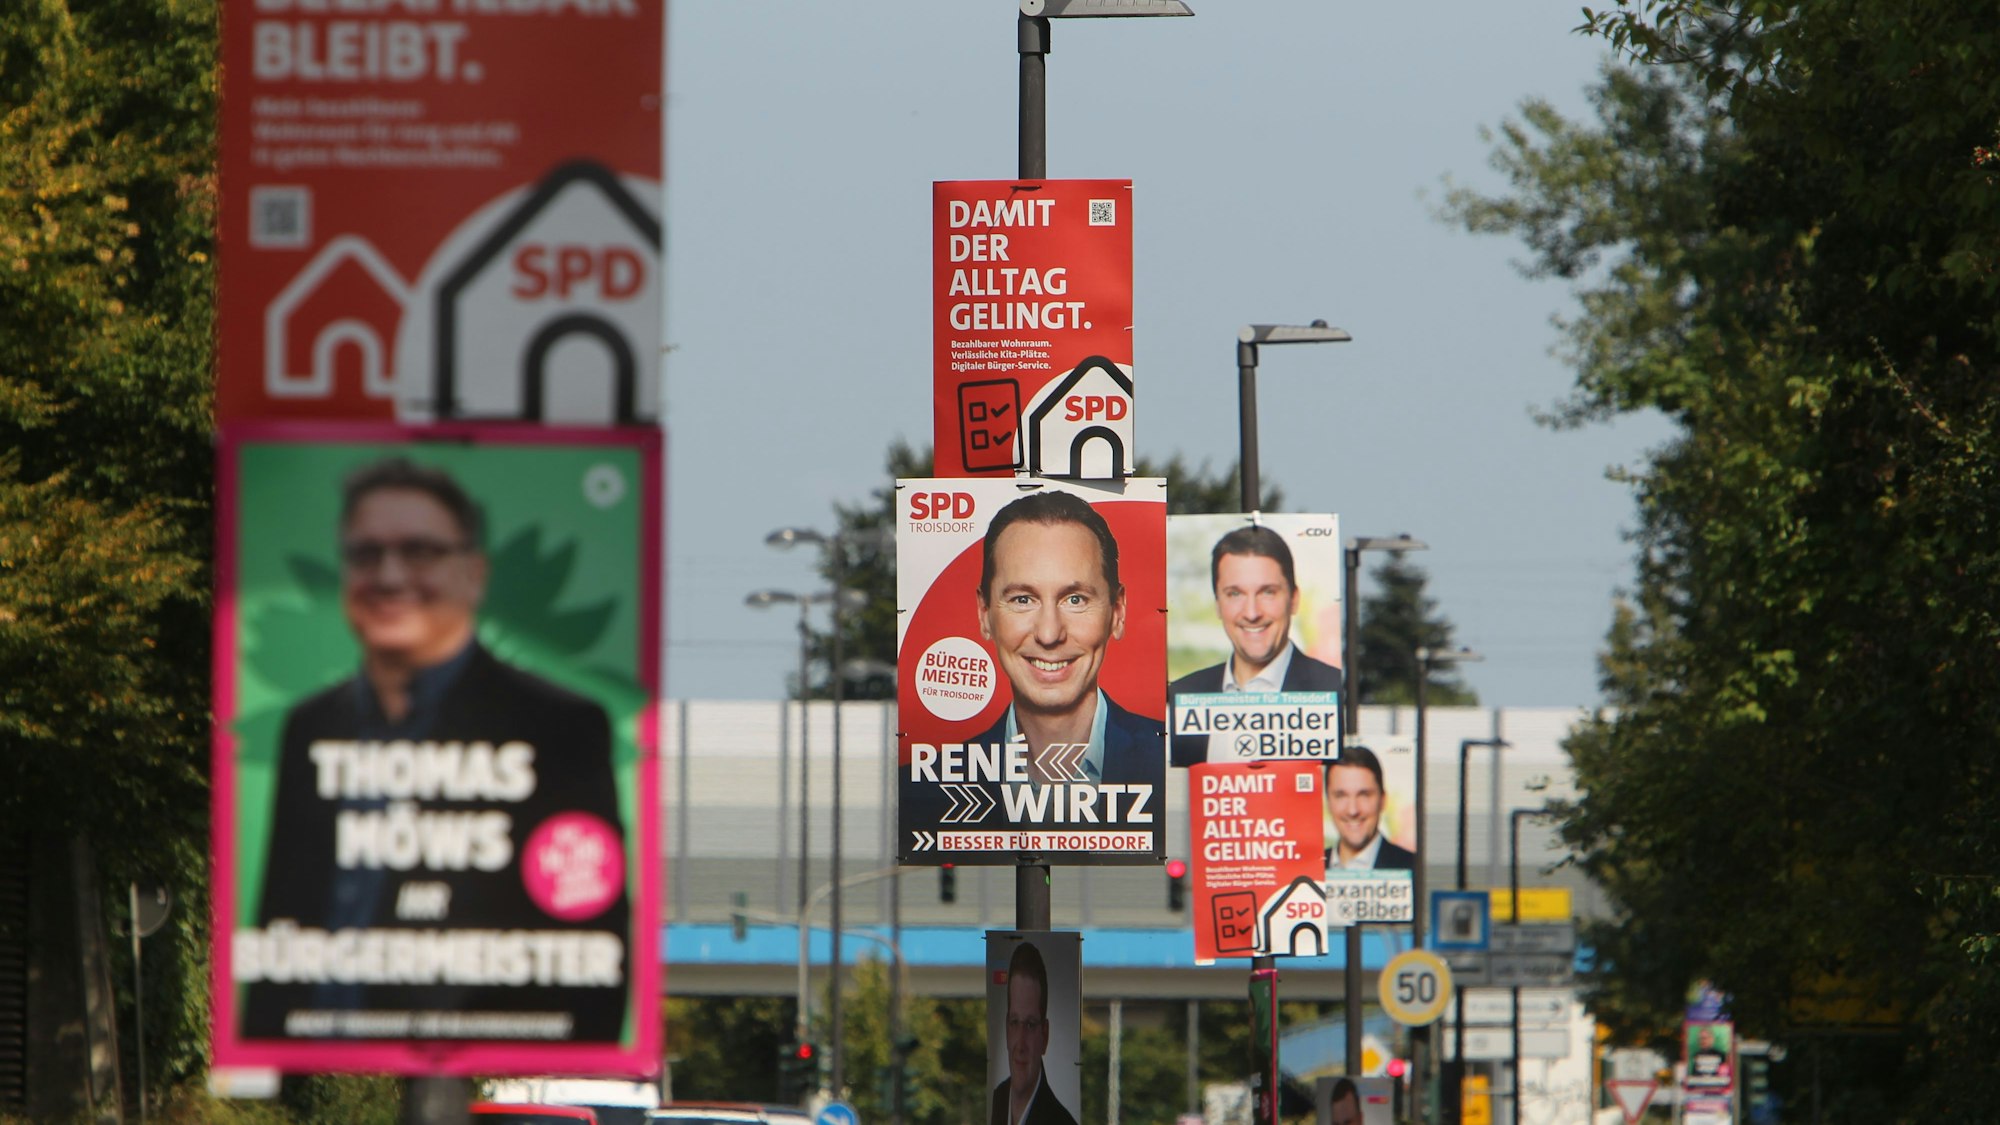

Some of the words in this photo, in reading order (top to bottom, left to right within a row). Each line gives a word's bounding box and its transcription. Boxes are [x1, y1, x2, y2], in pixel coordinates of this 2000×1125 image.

[252, 21, 483, 82] BLEIBT.
[949, 199, 1055, 228] DAMIT
[950, 234, 1010, 263] DER
[511, 244, 645, 301] SPD
[949, 267, 1067, 296] ALLTAG
[950, 301, 1092, 331] GELINGT.
[951, 340, 999, 349] Bezahlbarer
[1000, 339, 1052, 348] Wohnraum.
[951, 350, 999, 359] Verlässliche
[1000, 349, 1050, 358] Kita-Plätze.
[951, 361, 985, 372] Digitaler
[987, 360, 1052, 372] Bürger-Service.
[1064, 395, 1128, 421] SPD
[909, 492, 975, 520] SPD
[909, 522, 974, 533] TROISDORF
[1305, 527, 1332, 537] CDU
[926, 651, 988, 673] BÜRGER
[922, 668, 988, 688] MEISTER
[922, 686, 938, 697] FÜR
[939, 689, 985, 702] TROISDORF
[1180, 693, 1261, 706] Bürgermeister
[1263, 692, 1279, 704] für
[1182, 707, 1334, 731] Alexander
[1260, 732, 1335, 757] Biber
[309, 739, 537, 801] THOMAS
[911, 734, 1029, 783] RENÉ
[1202, 774, 1277, 795] DAMIT
[1001, 784, 1153, 823] WIRTZ
[1203, 797, 1247, 817] DER
[335, 801, 513, 870] MÖWS
[1203, 818, 1285, 839] ALLTAG
[942, 835, 1004, 849] BESSER
[1009, 832, 1042, 849] FÜR
[1047, 835, 1150, 849] TROISDORF.
[1204, 841, 1301, 861] GELINGT.
[1286, 902, 1324, 919] SPD
[1357, 901, 1410, 918] Biber
[232, 917, 624, 986] BÜRGERMEISTER
[1397, 972, 1437, 1004] 50
